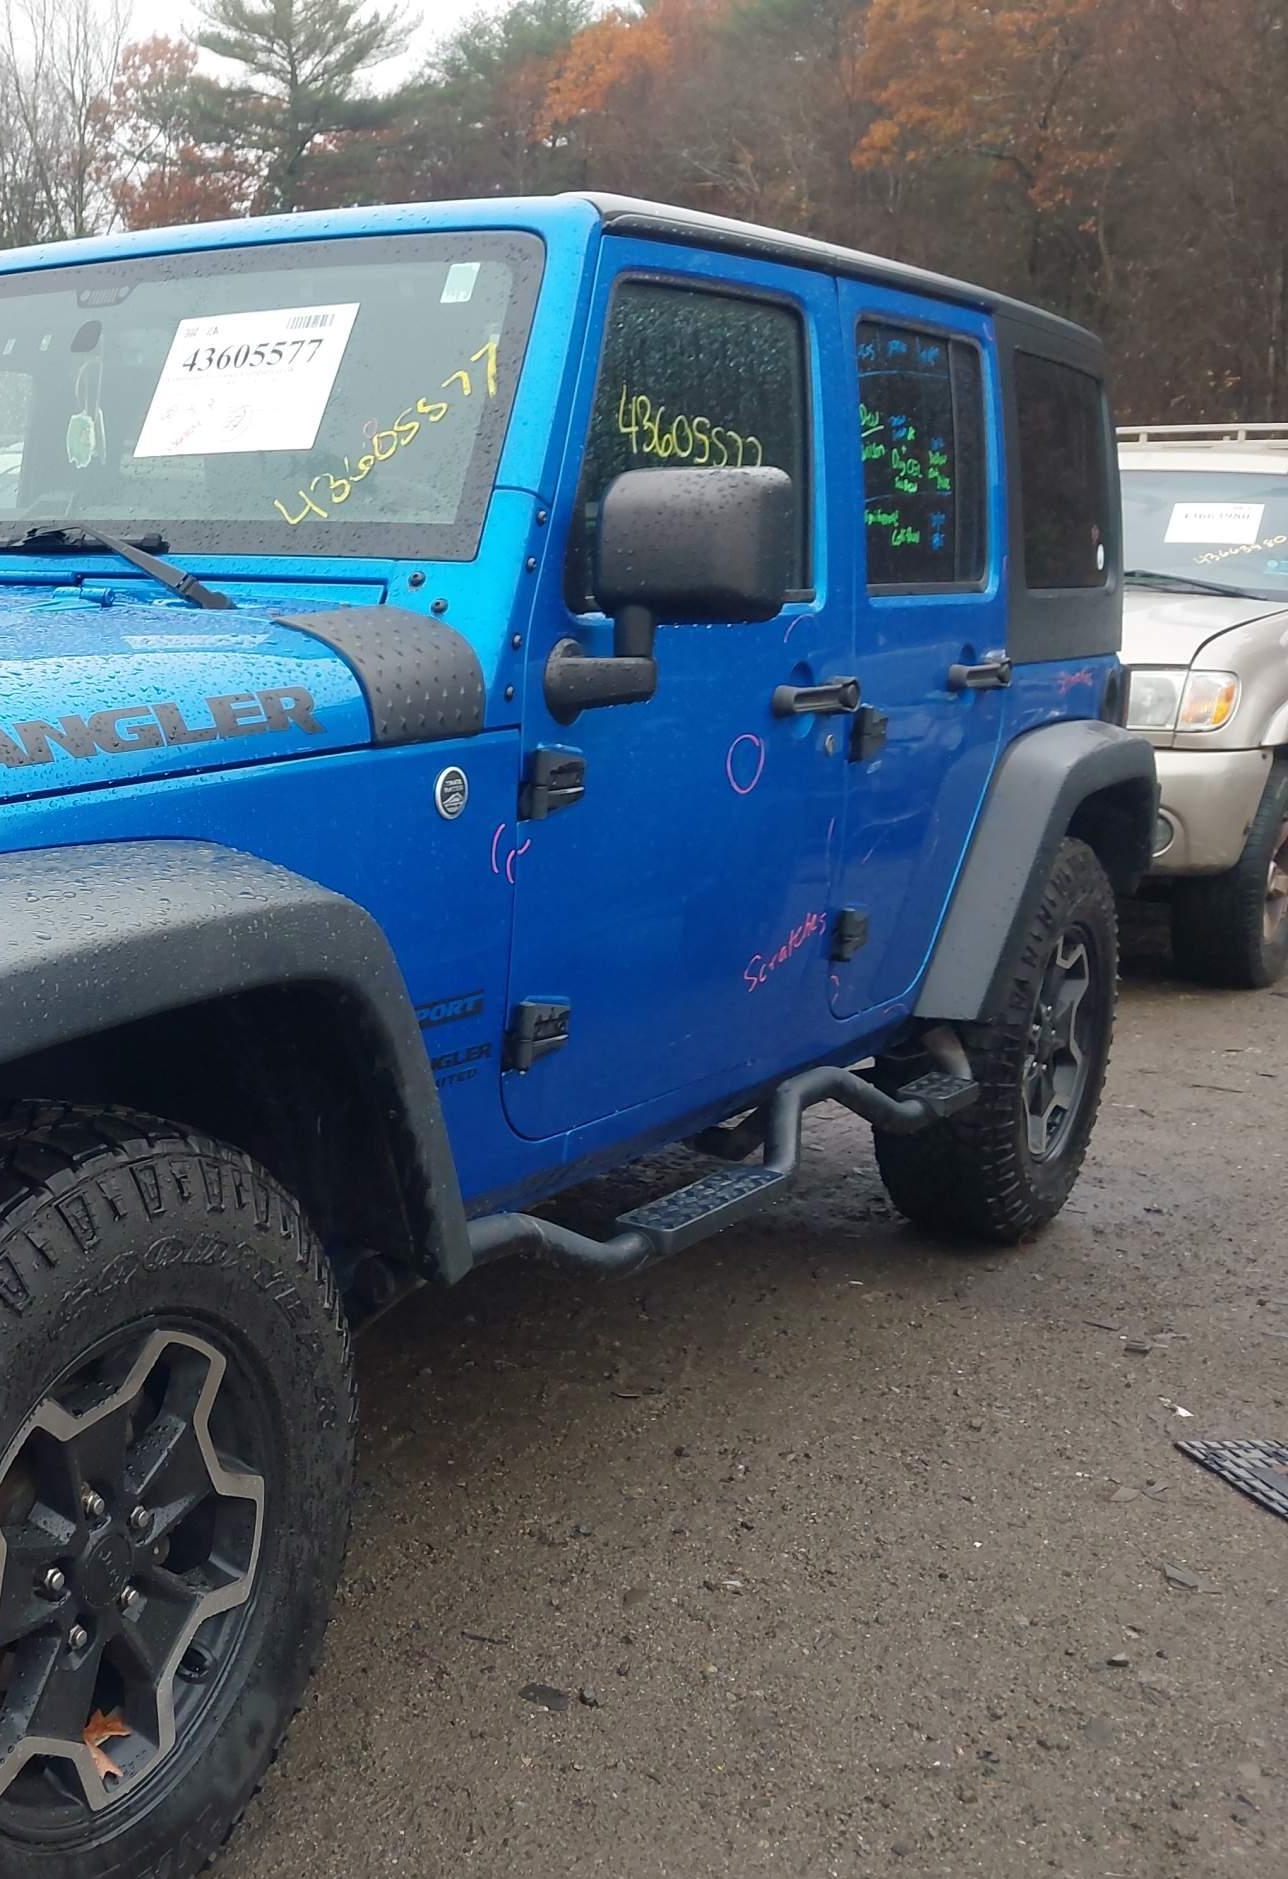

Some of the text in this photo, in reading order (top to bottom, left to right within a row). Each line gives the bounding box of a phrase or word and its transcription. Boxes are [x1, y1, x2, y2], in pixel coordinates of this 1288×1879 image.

[182, 338, 324, 373] 43605577
[274, 341, 499, 525] 43605577
[618, 383, 762, 468] 43605577
[415, 994, 484, 1022] PORT
